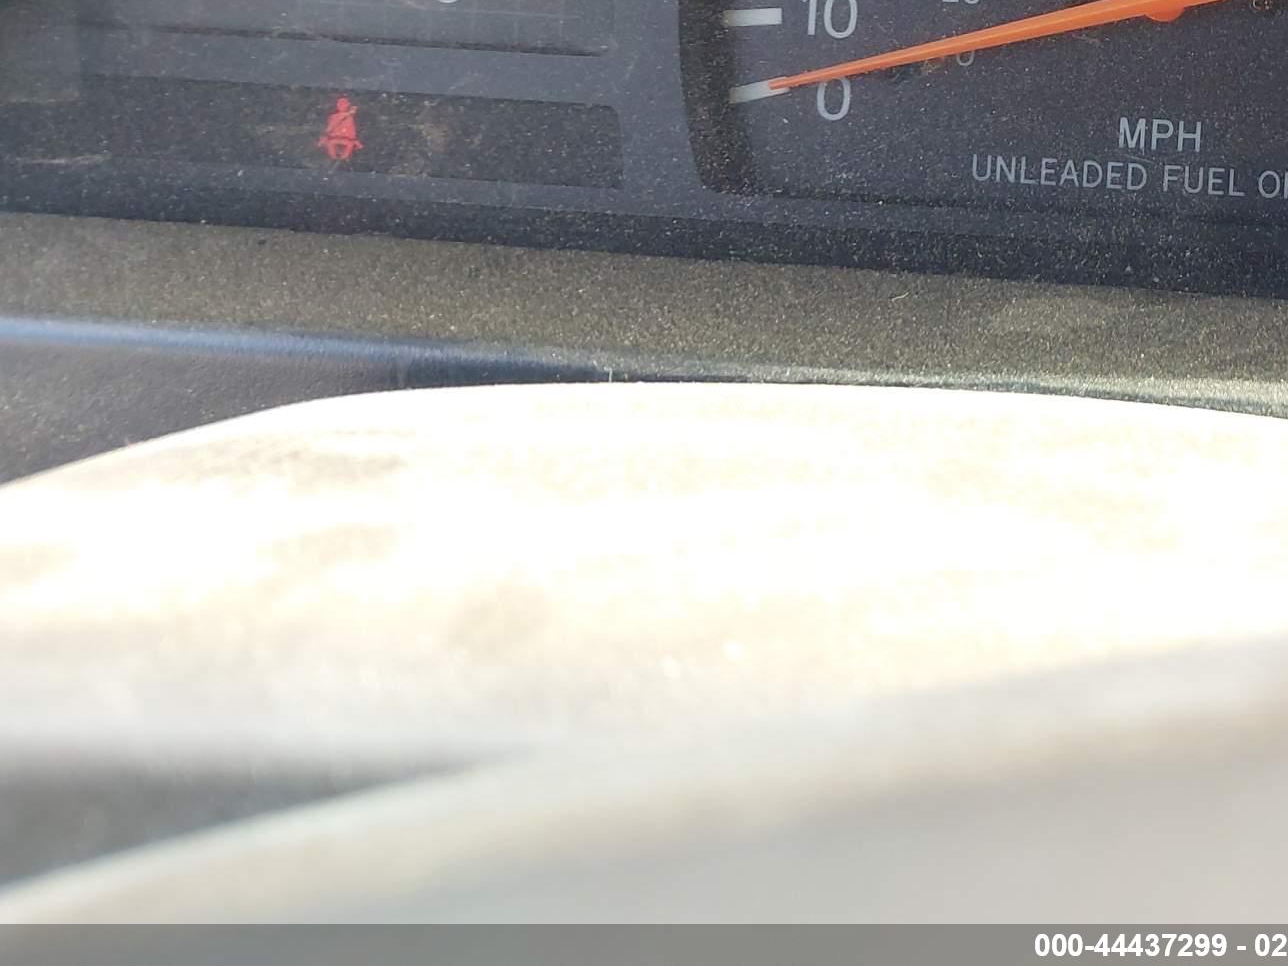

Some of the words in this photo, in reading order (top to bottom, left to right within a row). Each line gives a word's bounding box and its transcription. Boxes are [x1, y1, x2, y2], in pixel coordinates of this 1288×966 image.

[815, 76, 852, 121] 0
[1119, 117, 1201, 155] MPH
[973, 154, 1147, 190] UNLEADED
[1163, 165, 1244, 196] FUEL
